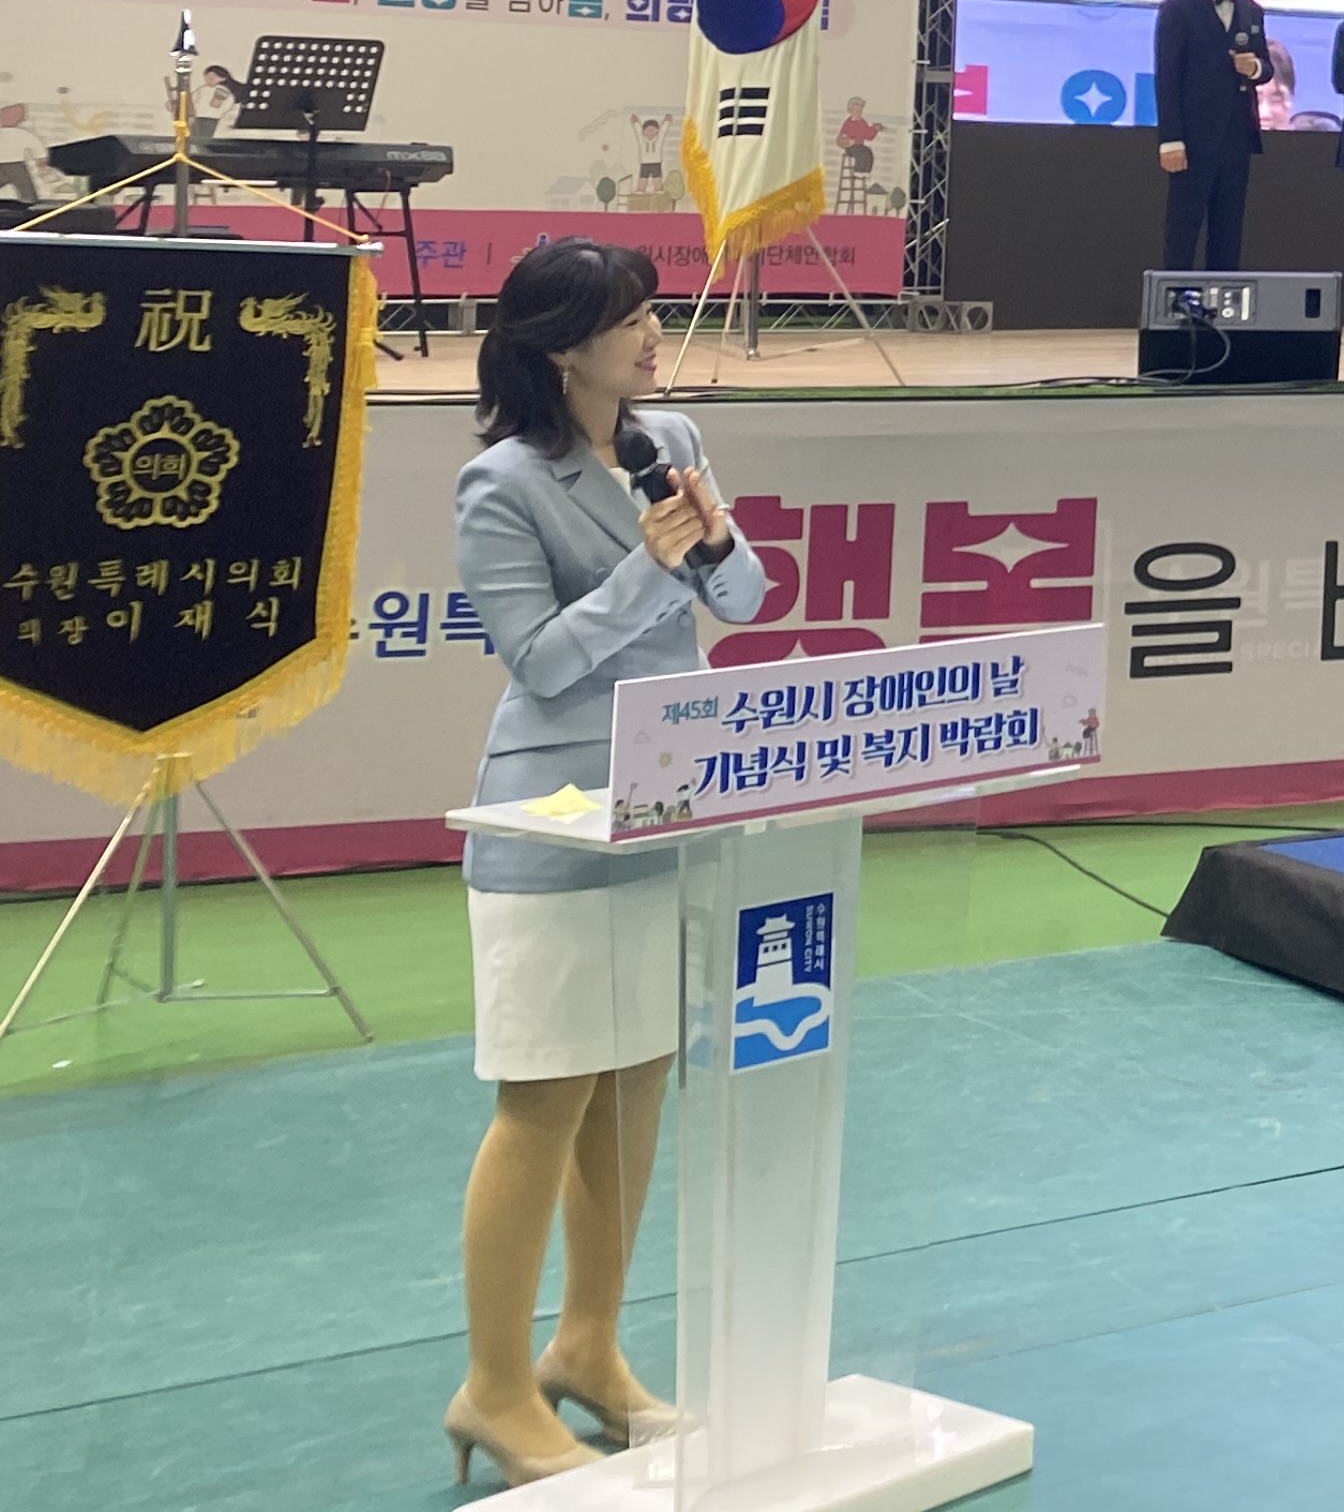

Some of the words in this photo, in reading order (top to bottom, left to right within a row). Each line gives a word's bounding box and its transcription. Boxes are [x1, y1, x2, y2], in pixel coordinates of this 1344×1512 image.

[416, 240, 468, 269] 주관
[134, 288, 214, 353] 祝
[707, 494, 1242, 680] 행복을
[661, 694, 719, 726] 제45회
[720, 680, 834, 735] 수원시
[843, 661, 981, 718] 장애인의
[990, 655, 1025, 698] 날
[693, 740, 807, 796] 기념식
[816, 734, 852, 779] 및
[860, 722, 930, 769] 복지
[939, 707, 1039, 757] 박람회
